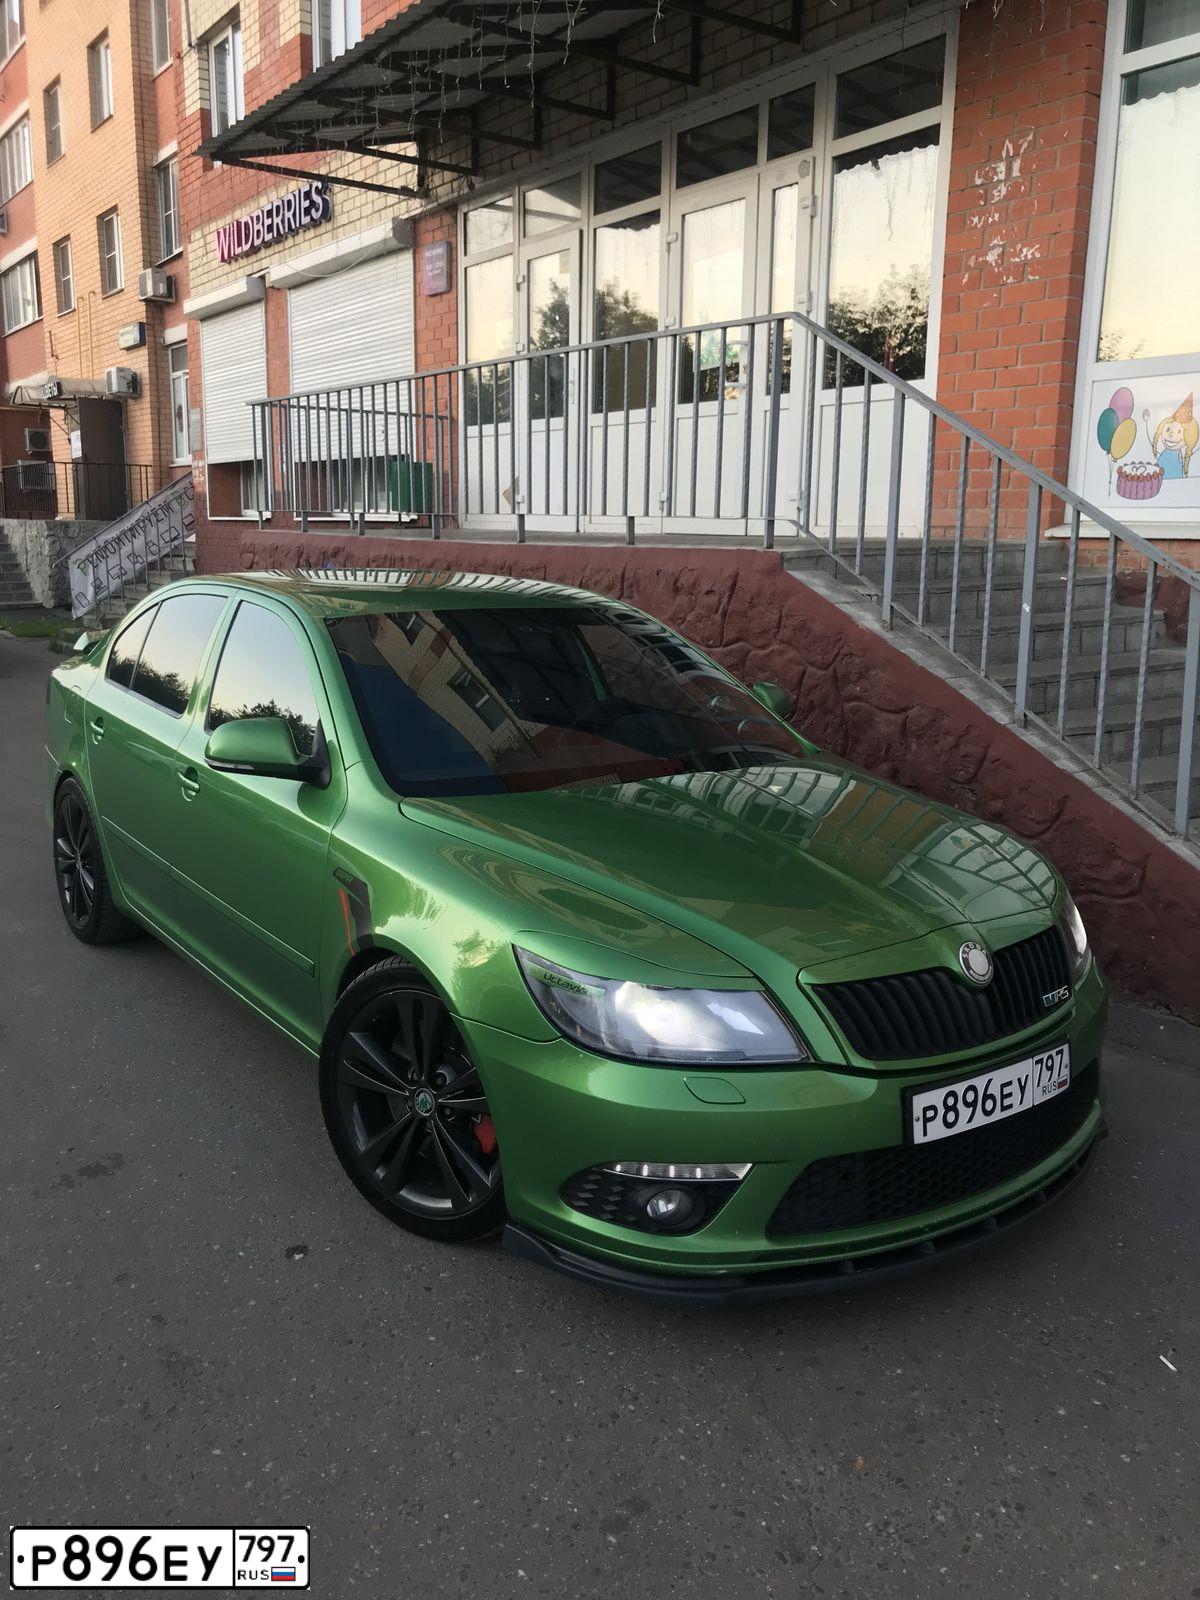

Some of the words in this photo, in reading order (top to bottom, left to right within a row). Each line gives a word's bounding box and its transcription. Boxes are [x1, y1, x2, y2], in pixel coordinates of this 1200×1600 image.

[215, 181, 324, 262] WILDBERRIES
[922, 1074, 1029, 1138] Р896ЕУ
[1034, 1048, 1064, 1088] 797
[1041, 1081, 1058, 1097] RUS
